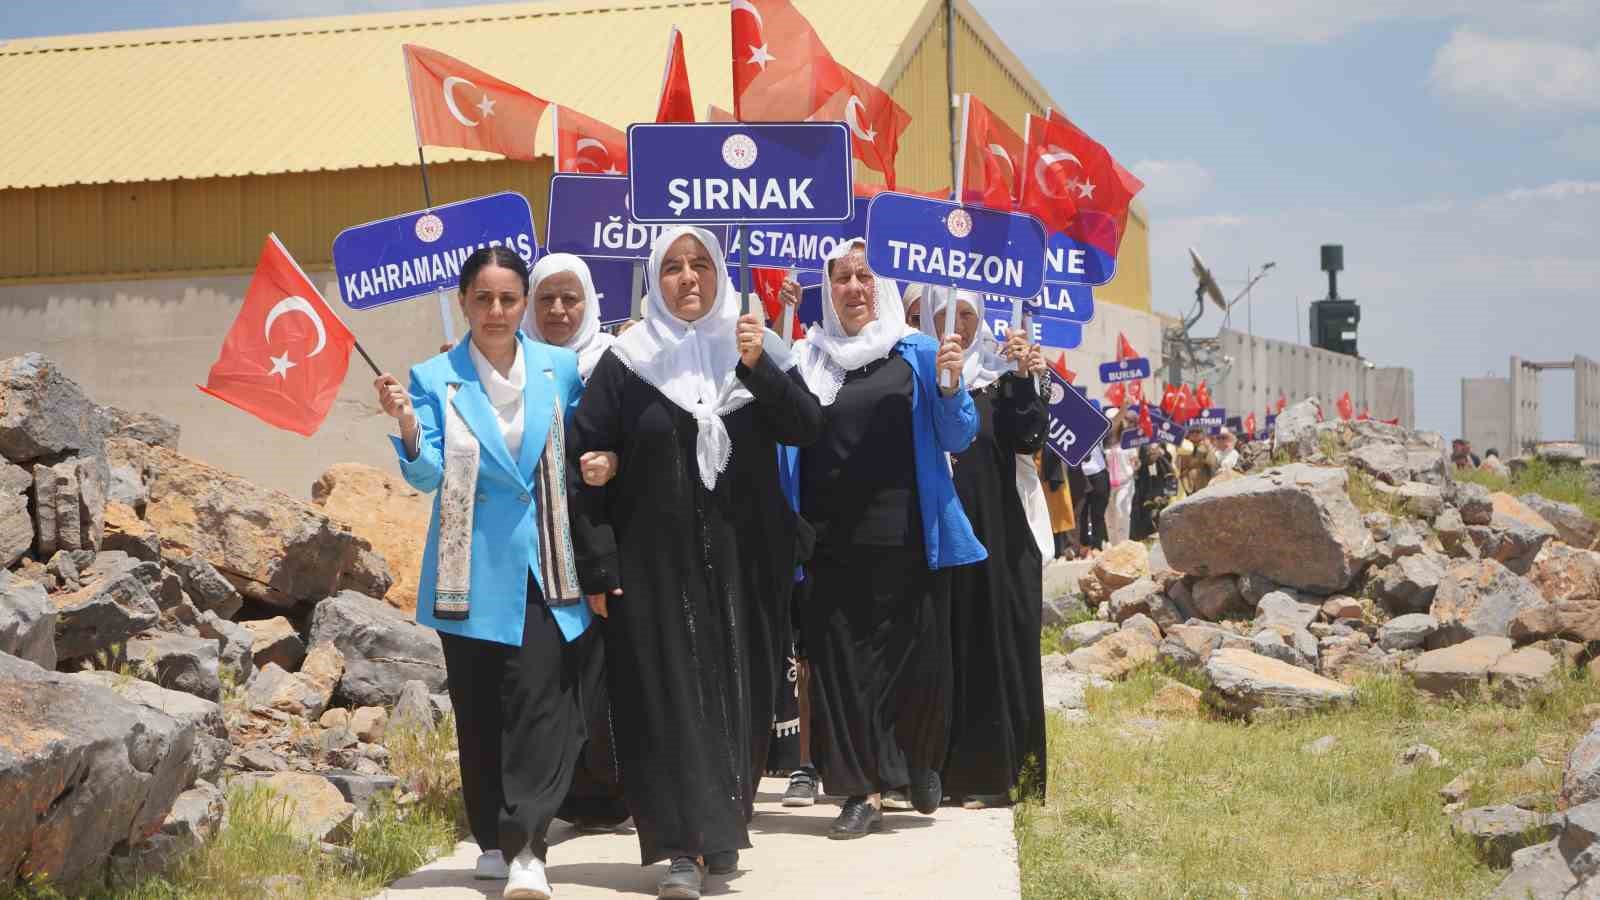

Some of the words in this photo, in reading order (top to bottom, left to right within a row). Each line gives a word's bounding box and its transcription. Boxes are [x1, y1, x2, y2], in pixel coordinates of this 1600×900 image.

[668, 178, 814, 216] ŞIRNAK
[593, 215, 658, 249] IĞDI
[729, 229, 848, 260] ASTAMO
[888, 240, 1023, 288] TRABZON
[1108, 368, 1143, 381] BURSA
[1048, 413, 1077, 452] UR
